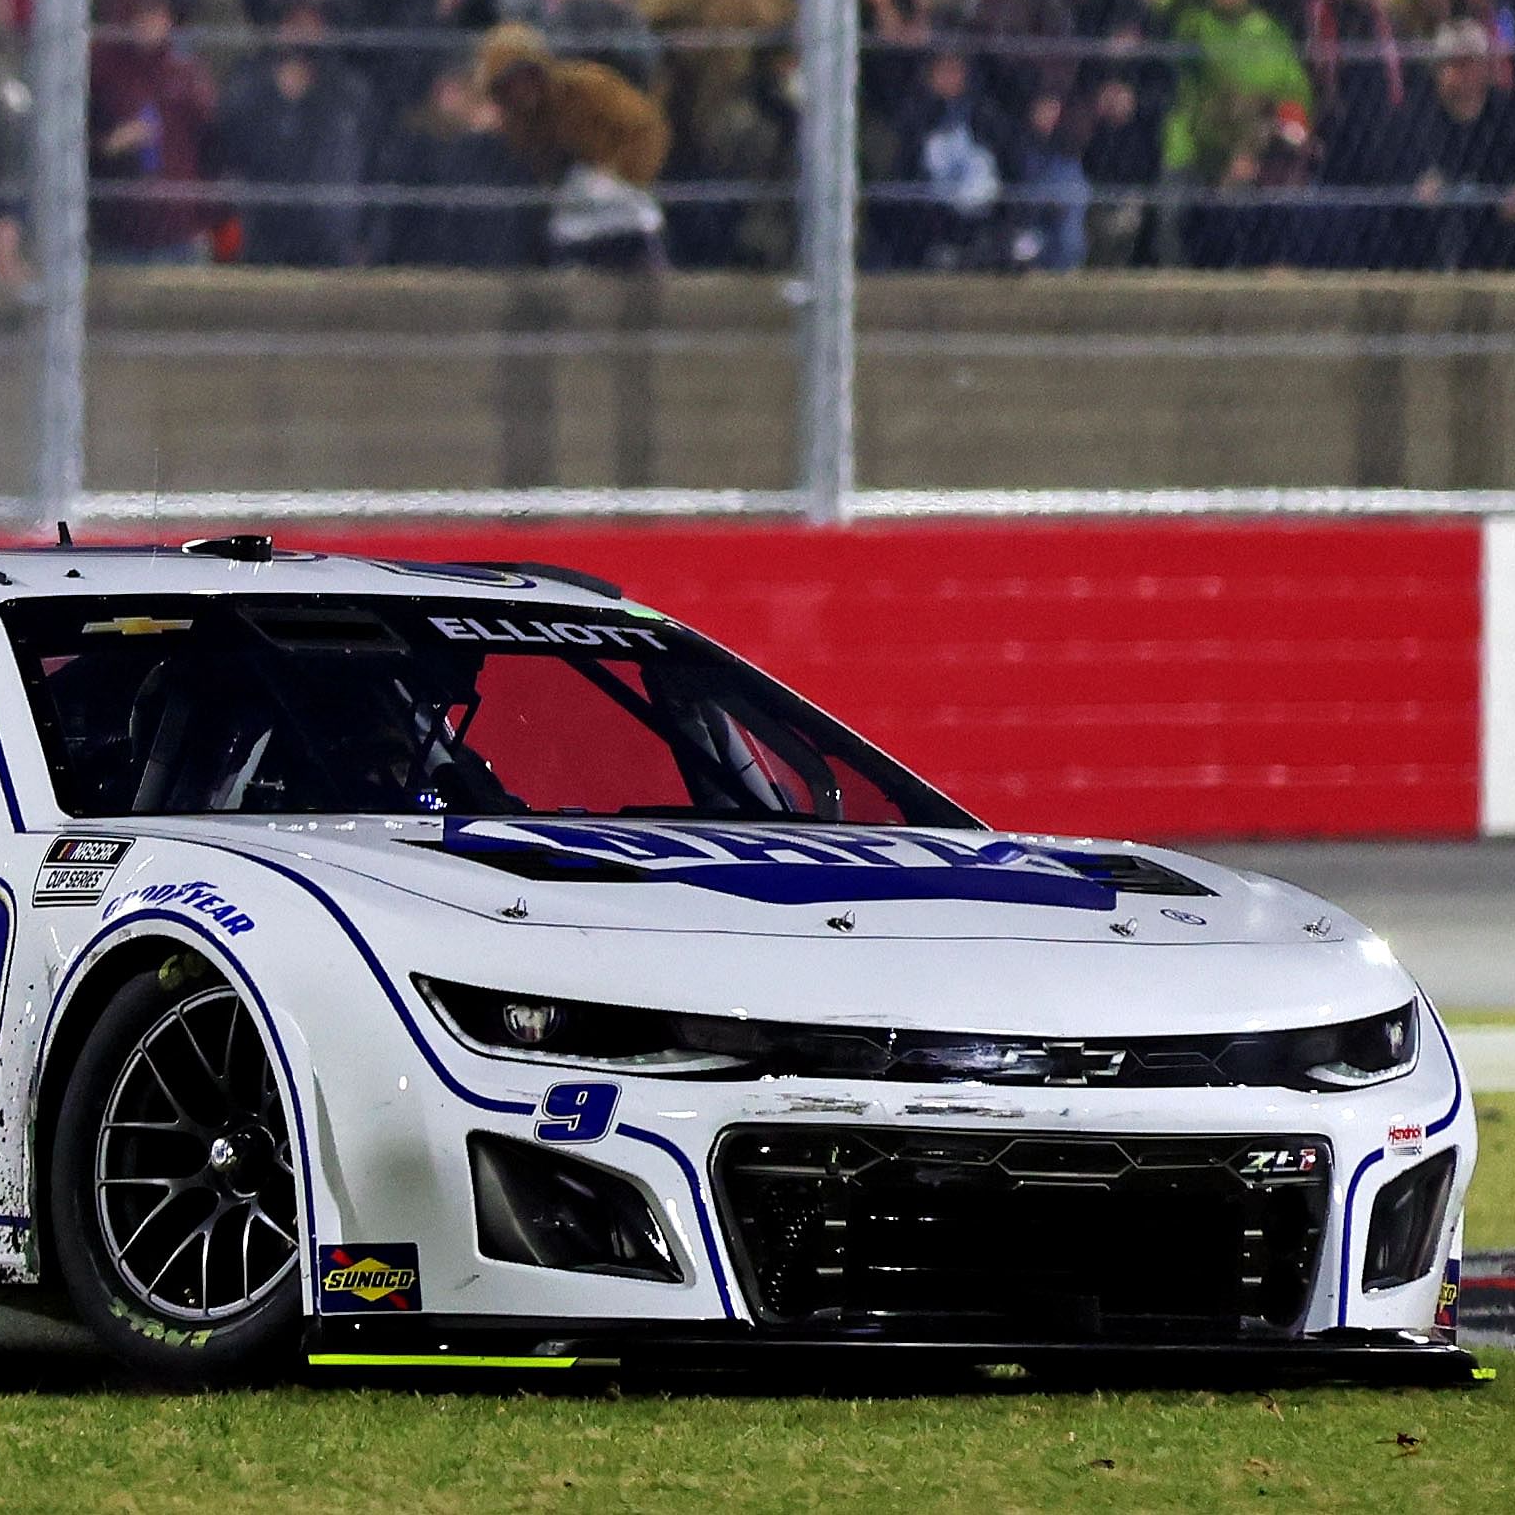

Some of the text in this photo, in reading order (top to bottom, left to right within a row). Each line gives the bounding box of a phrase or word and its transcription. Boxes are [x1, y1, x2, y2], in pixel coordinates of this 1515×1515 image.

[427, 616, 668, 651] ELLIOTT
[70, 842, 119, 862] NASCAR
[45, 870, 104, 889] CUP SERIES
[534, 1081, 623, 1144] 9
[327, 1270, 413, 1290] SUNOCO
